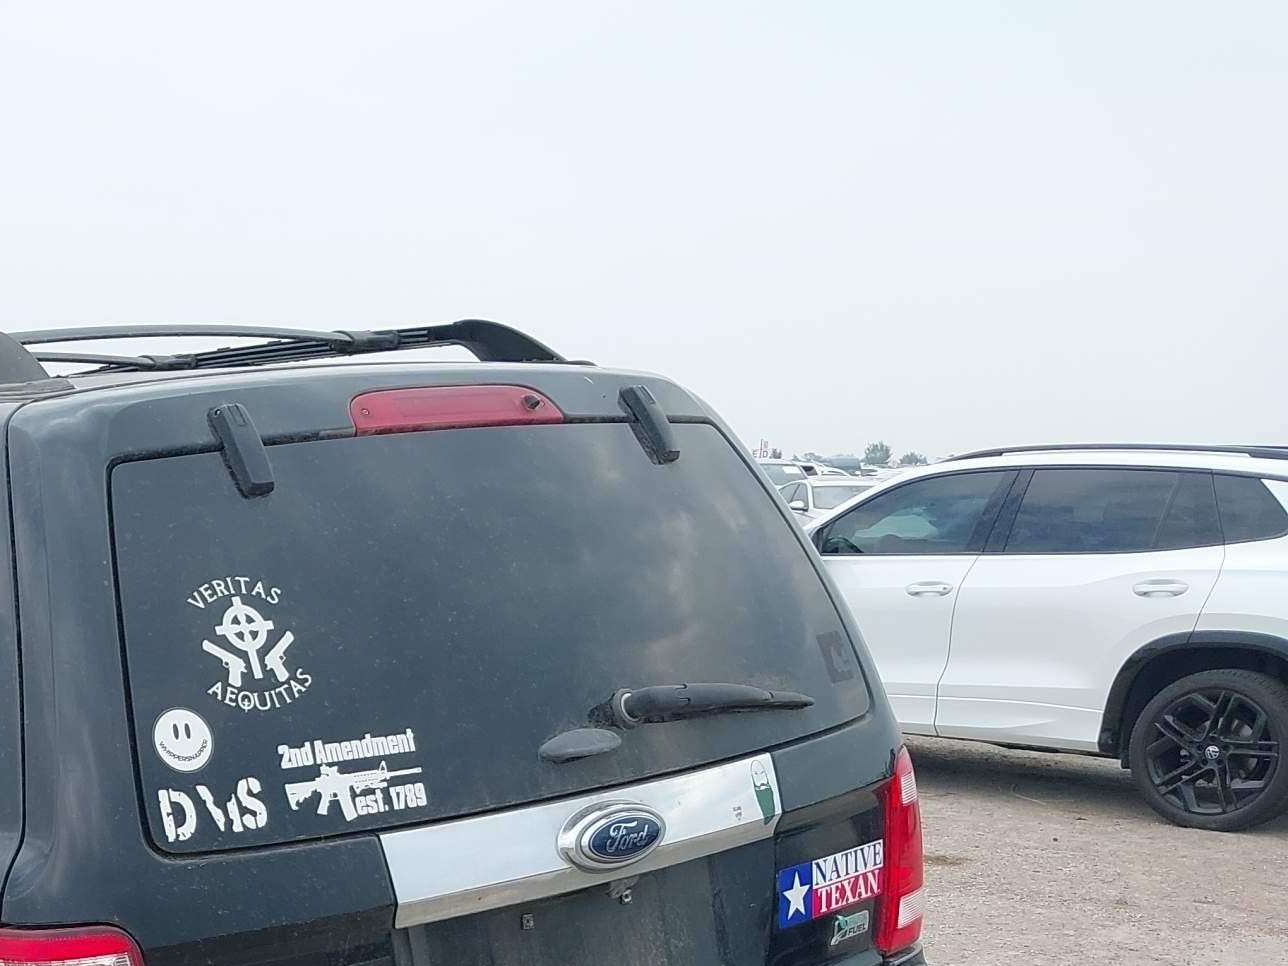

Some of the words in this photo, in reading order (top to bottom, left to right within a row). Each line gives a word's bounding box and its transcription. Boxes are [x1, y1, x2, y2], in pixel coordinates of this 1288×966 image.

[186, 576, 281, 609] VERITAS
[207, 668, 312, 713] AEQUITAS
[277, 741, 314, 769] 2nd
[313, 728, 416, 765] Amendment
[355, 789, 389, 816] est.
[389, 782, 427, 810] 1789
[606, 820, 650, 853] Ford
[814, 842, 883, 886] NATIVE
[817, 869, 880, 913] TEXAN
